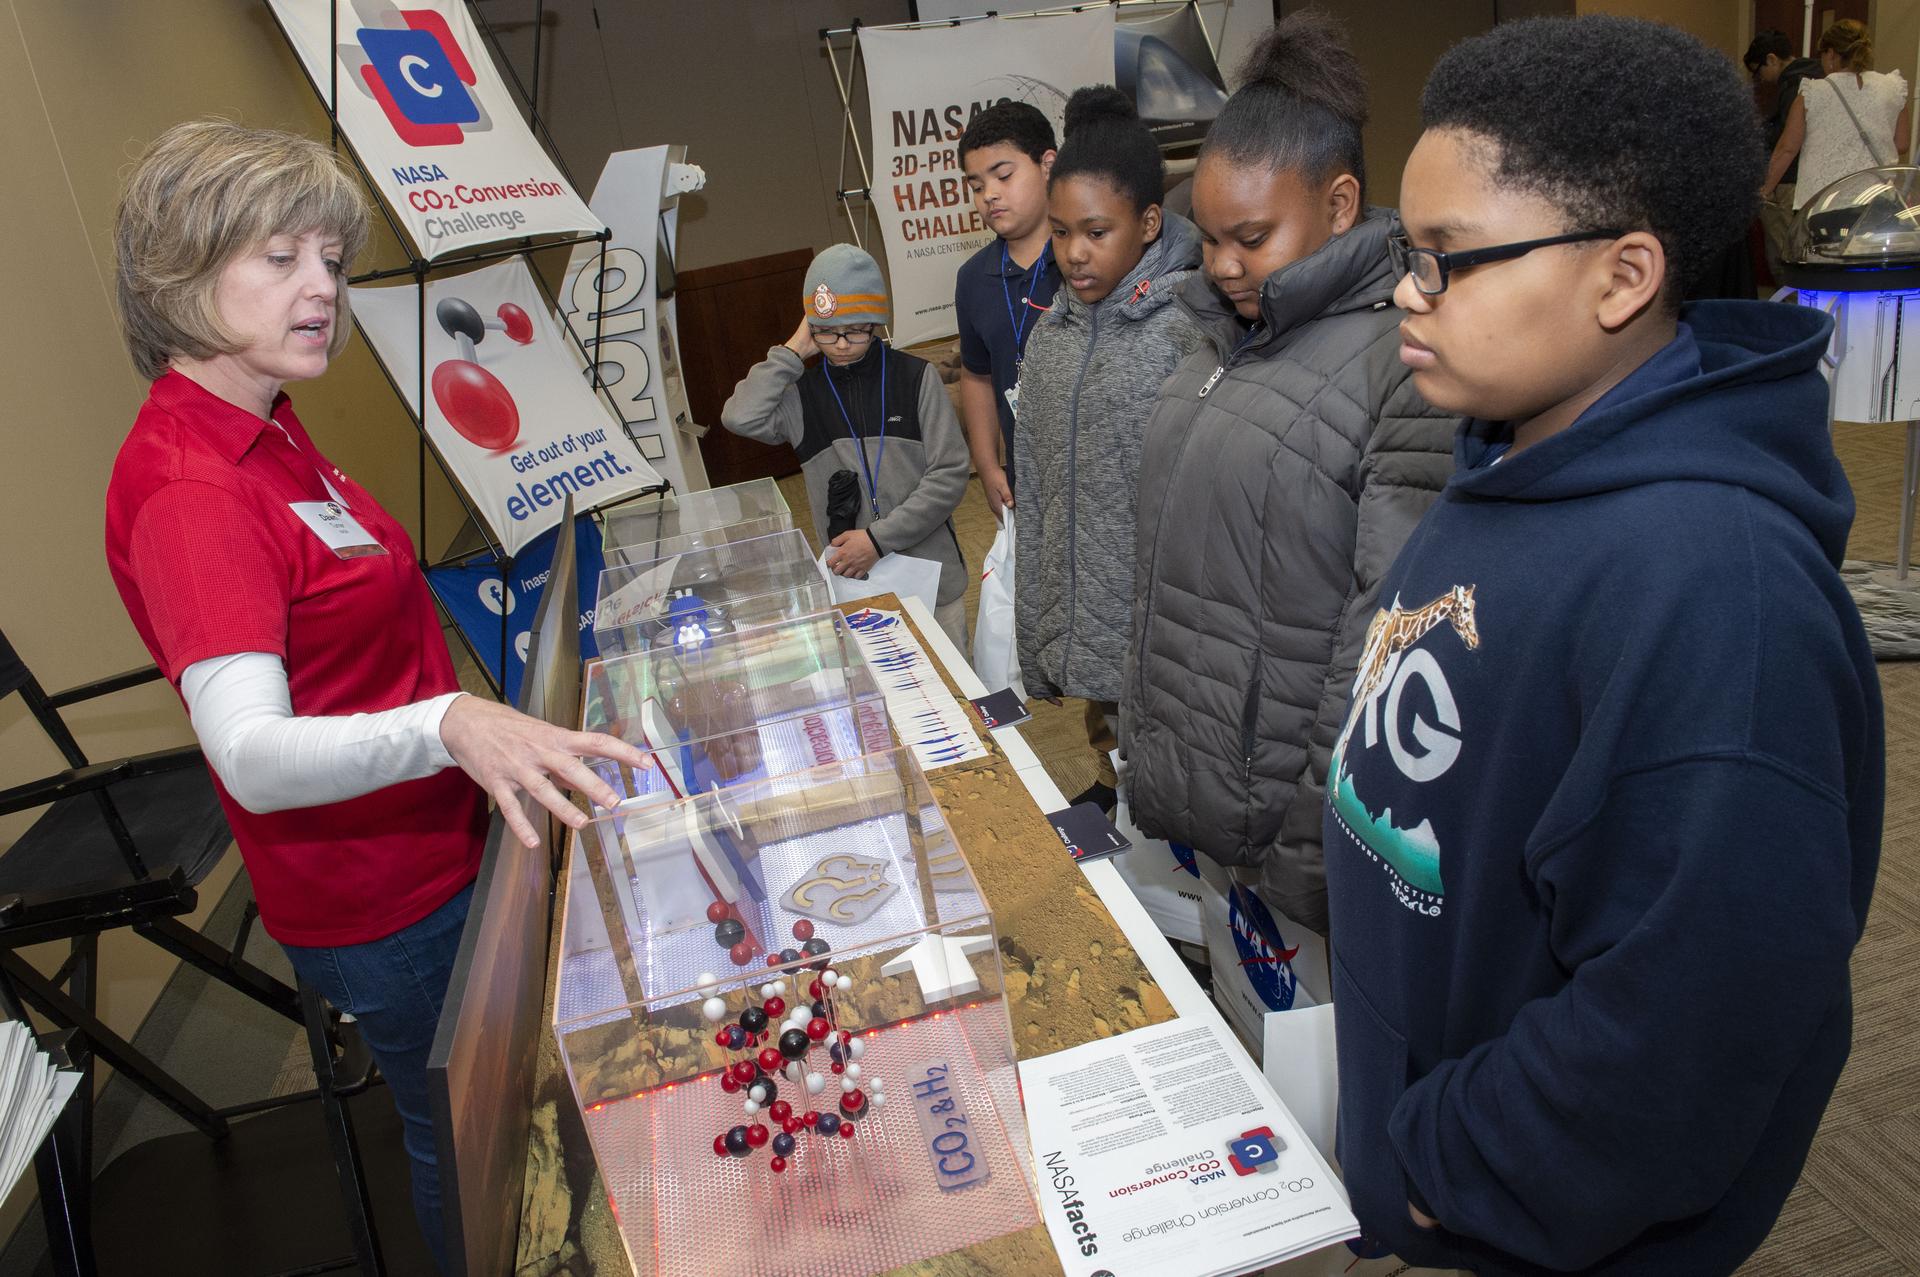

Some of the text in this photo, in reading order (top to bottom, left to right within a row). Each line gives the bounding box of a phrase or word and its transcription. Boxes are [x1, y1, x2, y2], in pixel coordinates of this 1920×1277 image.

[892, 97, 1013, 147] NASA'
[392, 164, 449, 186] NASA
[408, 177, 567, 213] CO2 Conversion
[893, 176, 971, 212] HABI
[425, 210, 526, 239] Challenge
[906, 250, 914, 260] A
[914, 245, 938, 259] NASA
[937, 239, 983, 255] CENTENNIAL
[510, 427, 608, 474] Get out of your
[506, 449, 633, 521] element.
[929, 1096, 956, 1114] &
[1145, 1149, 1215, 1175] Challenge
[1108, 1168, 1188, 1198] Conversion
[1190, 1169, 1226, 1186] NASA
[1198, 1187, 1280, 1219] Conversion
[1122, 1213, 1196, 1243] Challenge
